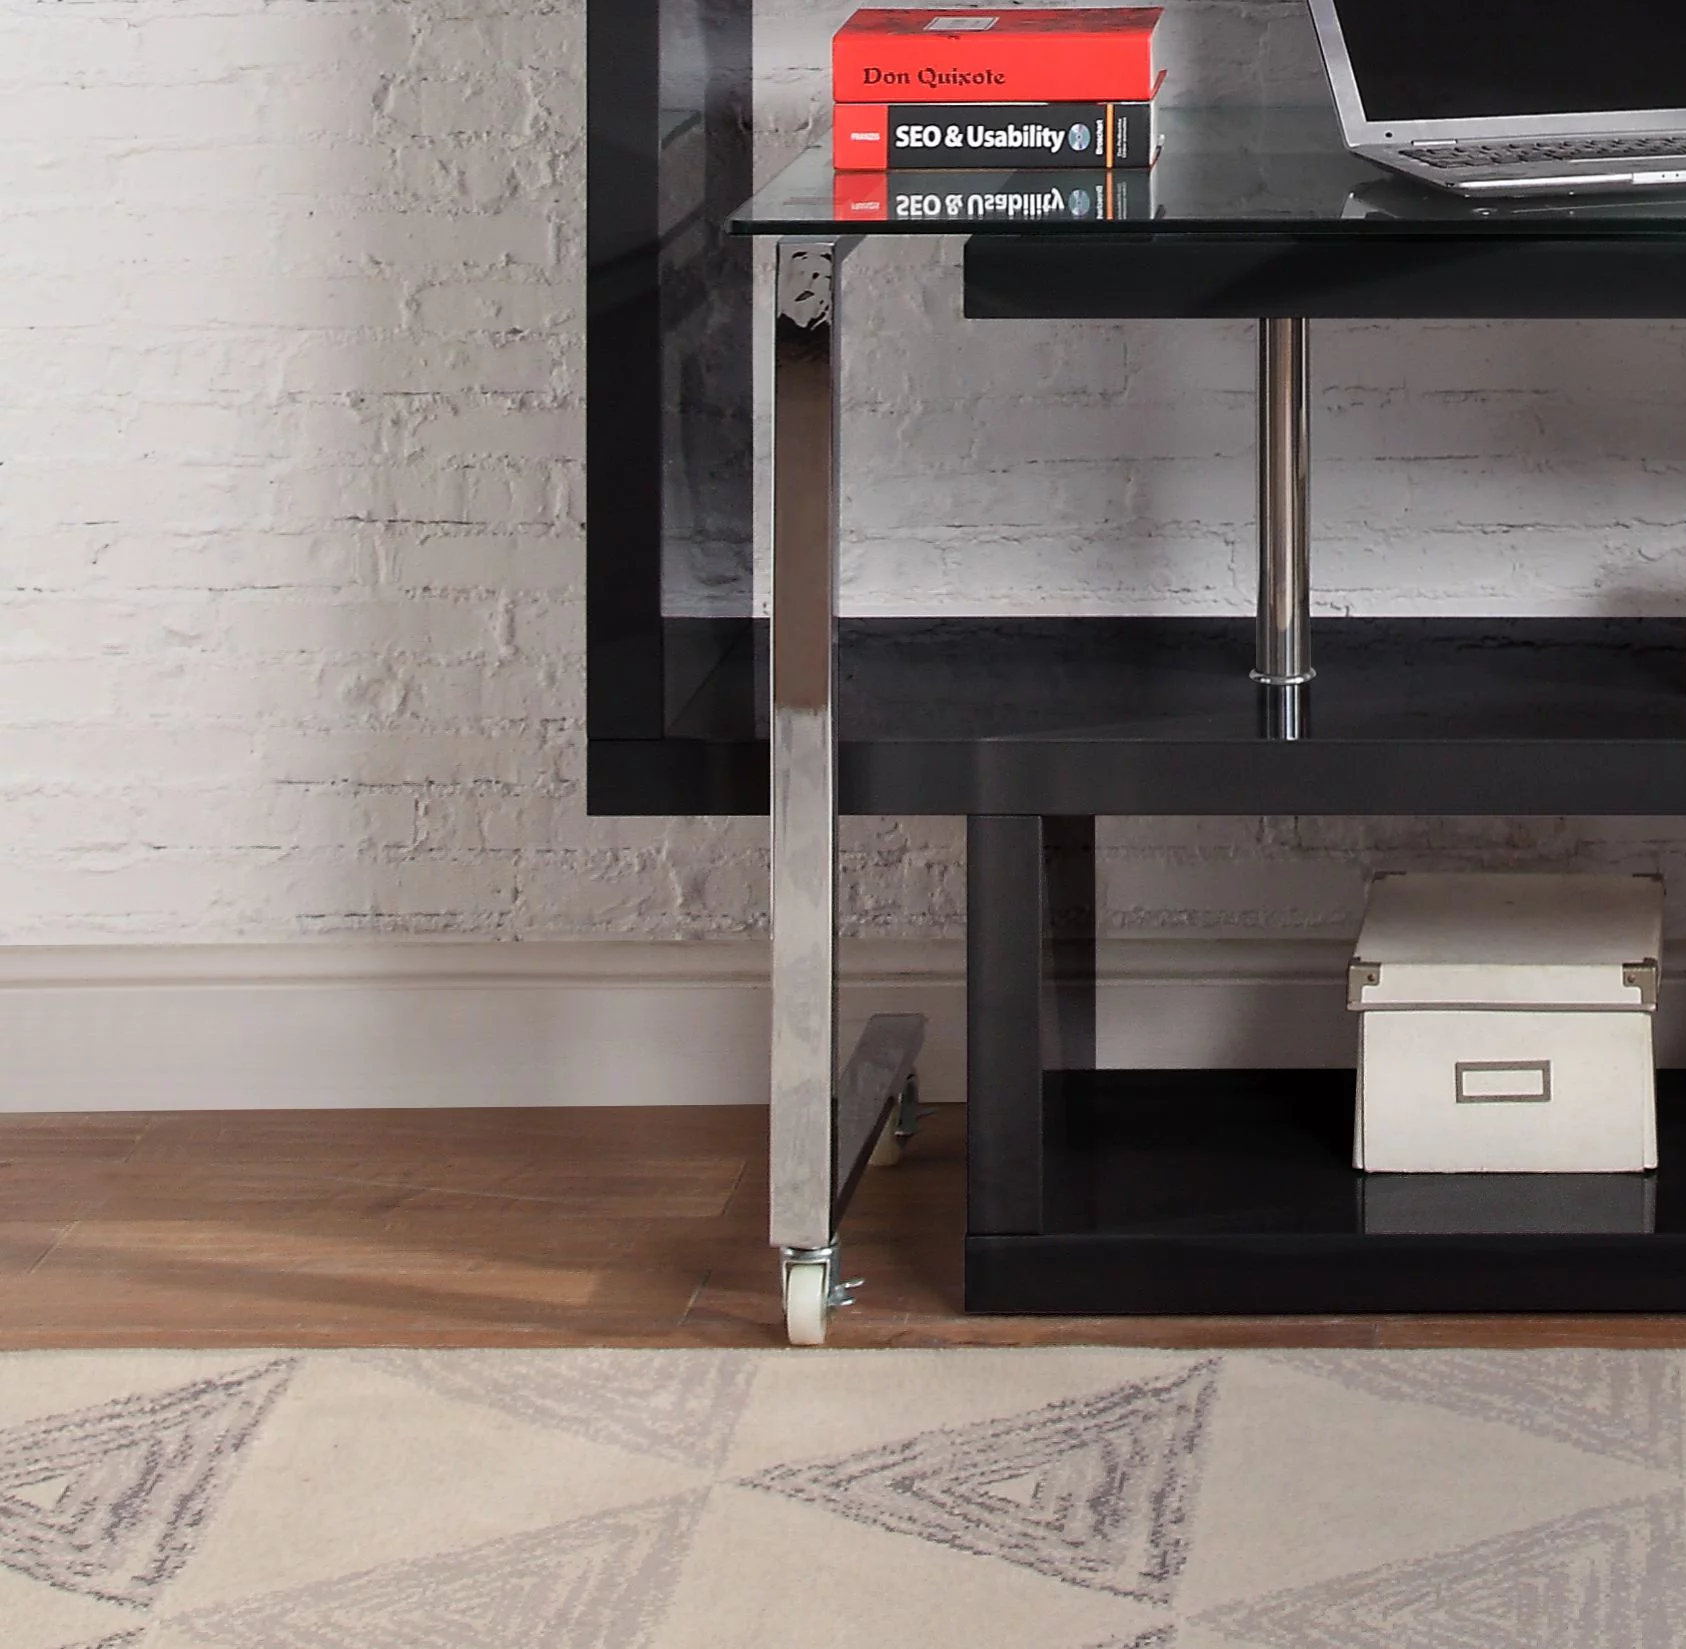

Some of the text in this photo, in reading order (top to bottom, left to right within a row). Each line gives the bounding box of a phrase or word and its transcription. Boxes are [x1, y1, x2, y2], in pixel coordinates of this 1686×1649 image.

[863, 68, 1006, 89] Don Quixote
[895, 124, 1065, 153] SEO & Usability
